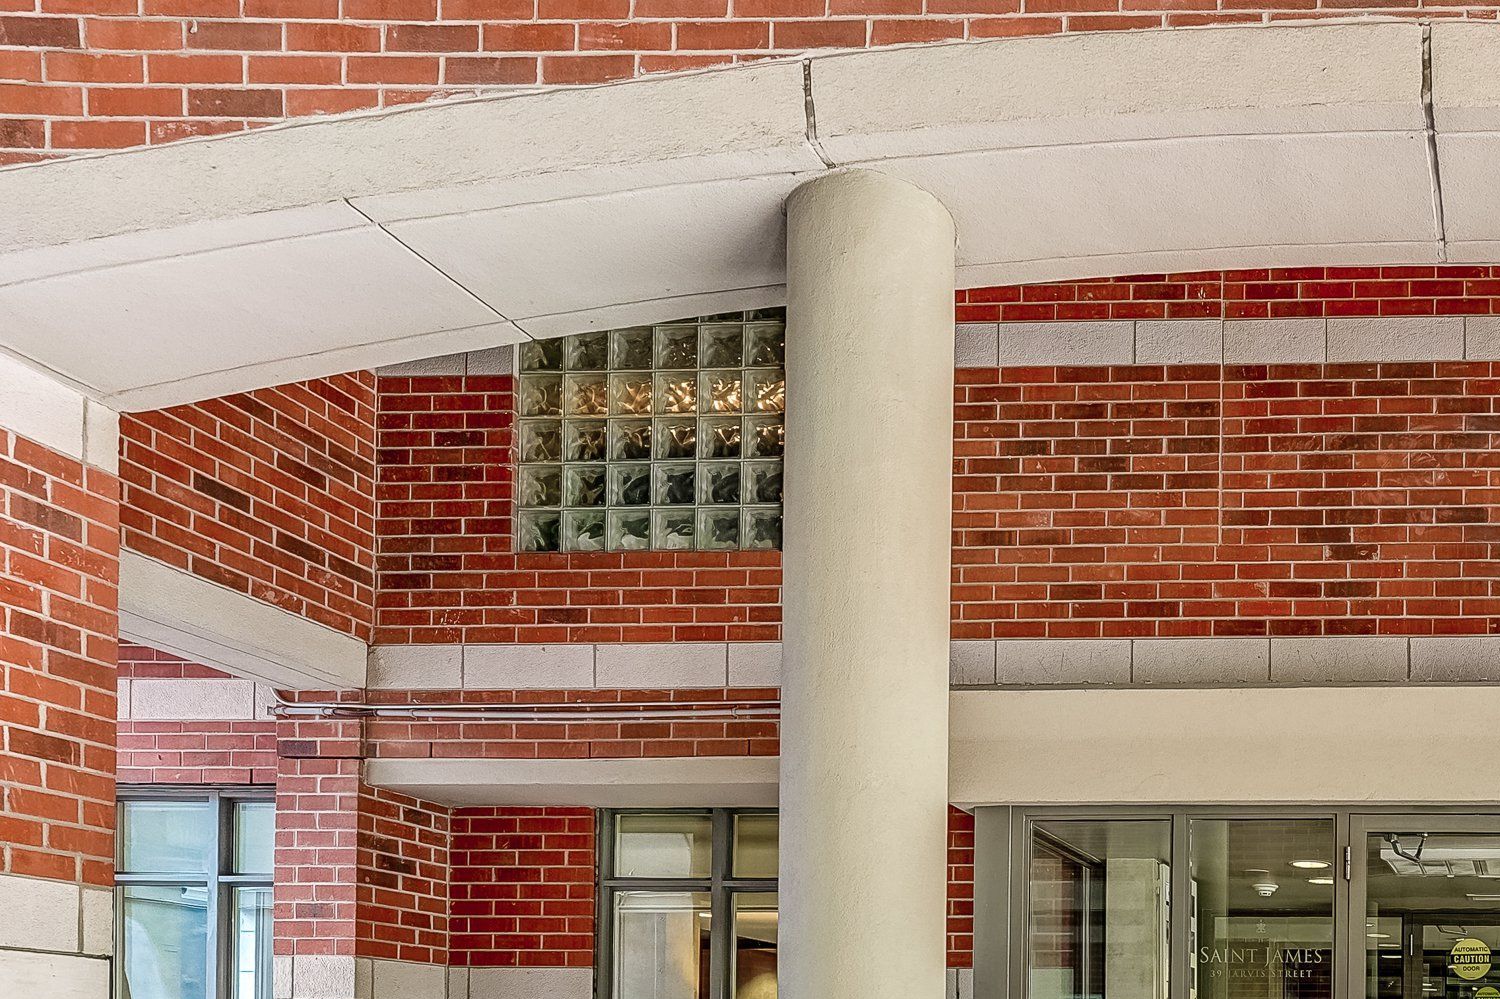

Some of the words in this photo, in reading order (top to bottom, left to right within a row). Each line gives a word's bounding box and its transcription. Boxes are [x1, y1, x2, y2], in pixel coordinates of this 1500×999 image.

[1200, 947, 1258, 963] SAINT
[1264, 947, 1322, 967] JAMES
[1454, 955, 1489, 963] CAUTION
[1210, 970, 1222, 978] 39
[1228, 970, 1265, 978] JARVIS
[1272, 970, 1313, 978] STREET
